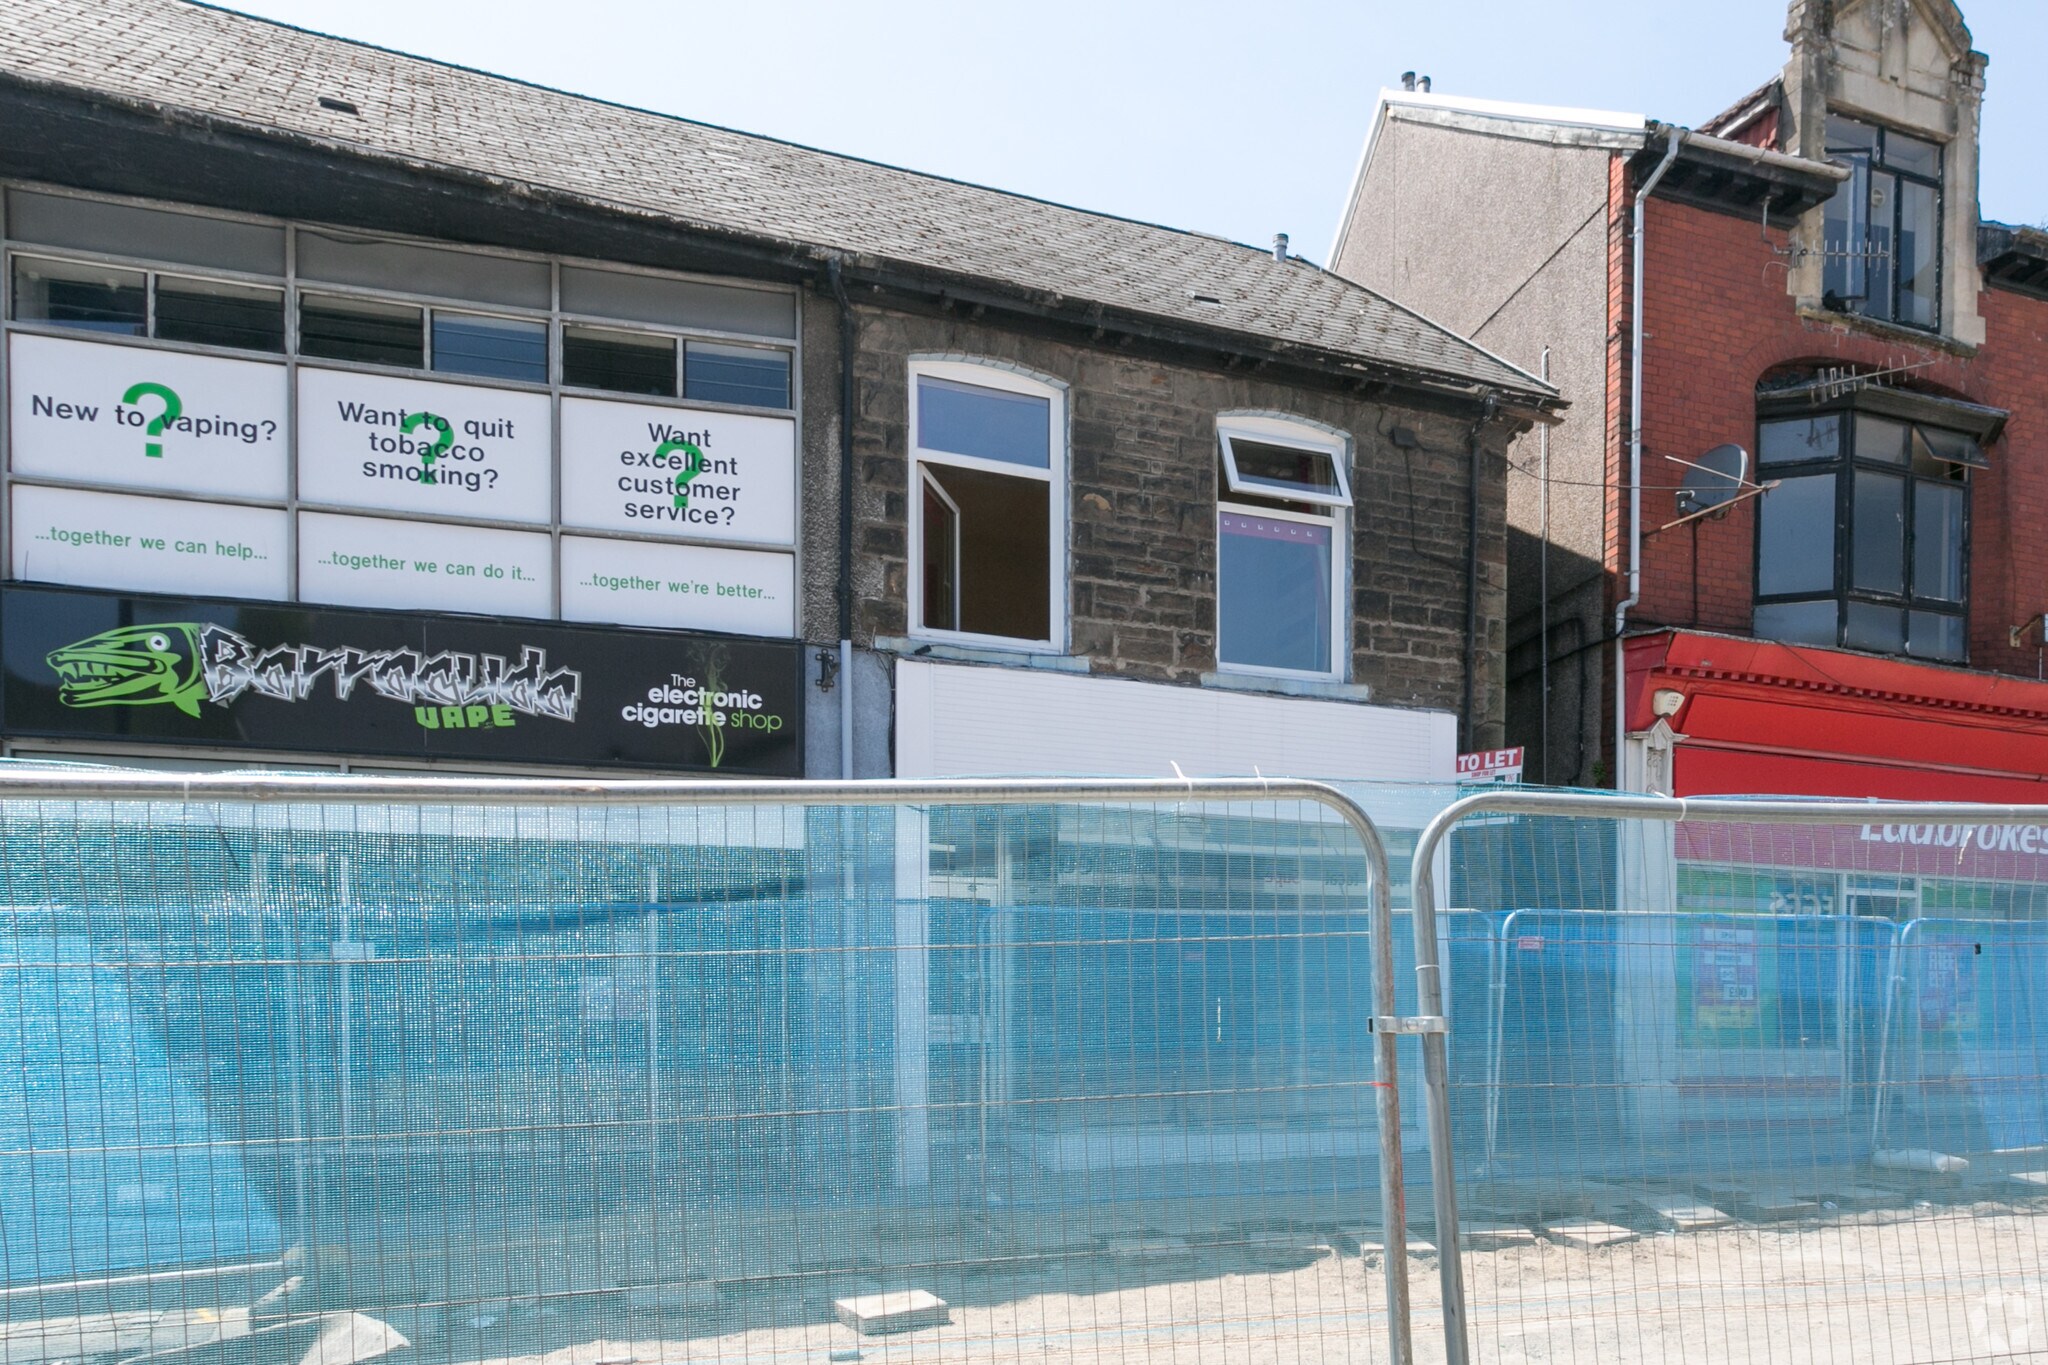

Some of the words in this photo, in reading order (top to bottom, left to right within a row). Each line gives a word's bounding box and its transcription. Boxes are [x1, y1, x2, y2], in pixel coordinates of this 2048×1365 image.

[32, 394, 99, 422] New
[115, 404, 145, 427] to
[161, 414, 277, 444] vaping?
[338, 400, 408, 428] Want
[422, 411, 450, 432] to
[464, 418, 515, 439] quit
[369, 432, 485, 462] tobacco
[648, 422, 712, 447] Want
[362, 461, 499, 492] smoking?
[620, 450, 738, 475] excellent
[618, 475, 741, 501] customer
[624, 501, 735, 526] service?
[35, 525, 131, 549] ...together
[140, 537, 166, 550] we
[175, 539, 207, 554] can
[215, 541, 268, 562] help...
[318, 551, 406, 571] ...together
[414, 561, 438, 573] we
[446, 563, 476, 576] can
[483, 564, 504, 579] do
[512, 566, 535, 582] it...
[580, 573, 661, 591] ...together
[668, 580, 709, 594] we're
[717, 582, 775, 600] better...
[200, 622, 582, 722] Barracuda
[671, 673, 696, 687] The
[648, 684, 763, 709] electronic
[621, 702, 726, 728] cigarette
[731, 709, 783, 733] shop
[1458, 754, 1480, 772] TO
[1485, 749, 1518, 769] LET
